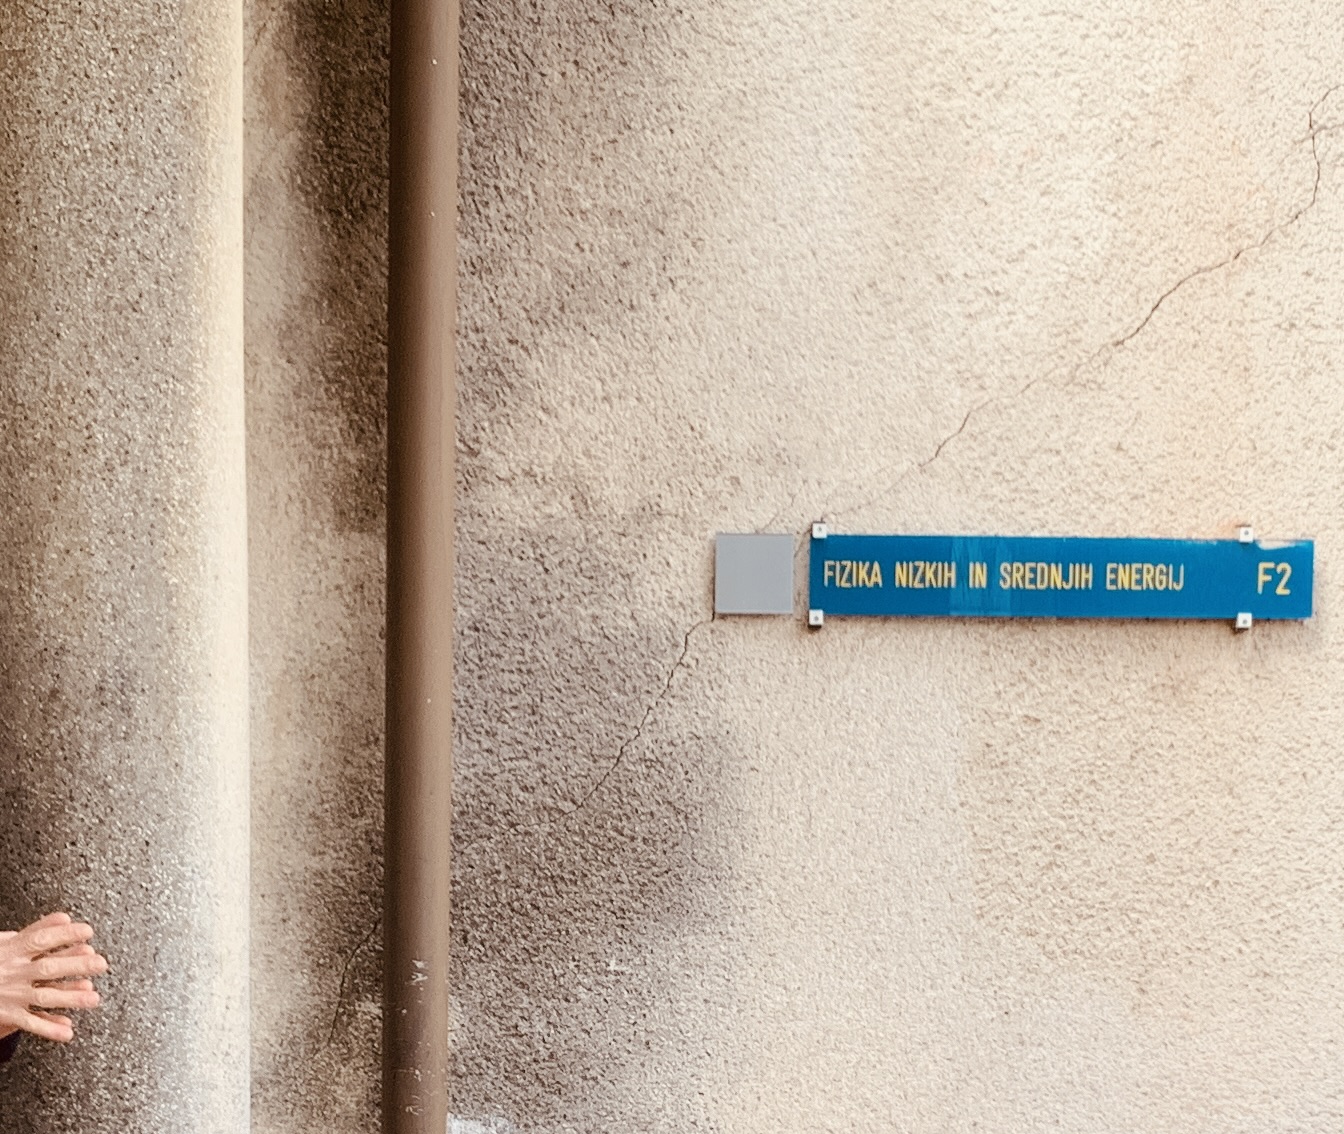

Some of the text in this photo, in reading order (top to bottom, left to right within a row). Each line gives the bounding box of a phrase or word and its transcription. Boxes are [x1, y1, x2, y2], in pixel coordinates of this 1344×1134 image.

[823, 560, 1185, 591] FIZIKA NIZKIH IN SREDNJIH ENERGIJ
[1257, 561, 1293, 596] F2
